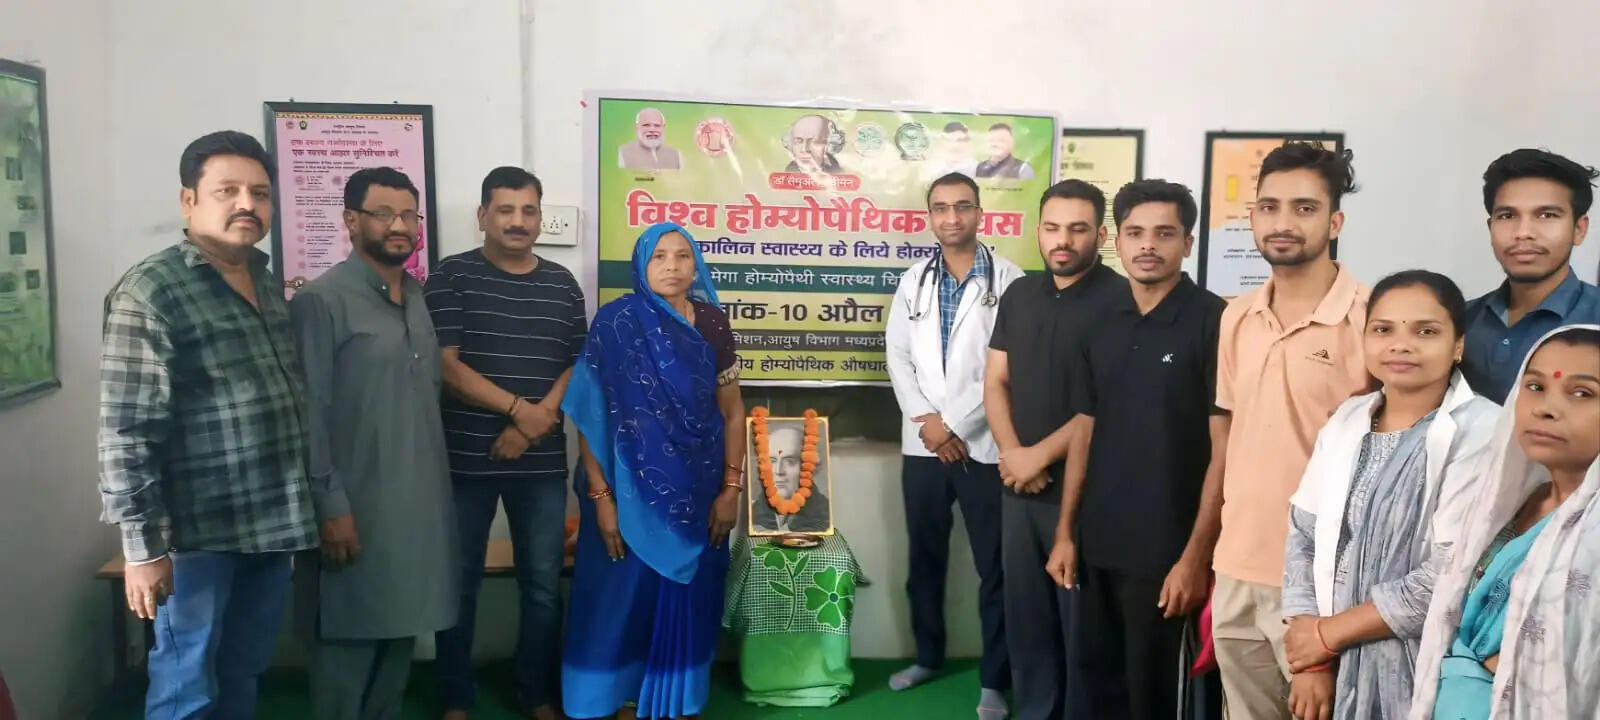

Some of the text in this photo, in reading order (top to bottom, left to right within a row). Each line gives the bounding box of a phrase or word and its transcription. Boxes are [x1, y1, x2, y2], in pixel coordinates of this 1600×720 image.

[626, 189, 1024, 237] विश्व होम्योपैथिक वस
[761, 242, 822, 257] स्वास्थ्य
[829, 240, 848, 258] के
[854, 240, 890, 259] लिये
[896, 241, 942, 259] होम्यो
[711, 267, 738, 283] मेगा
[745, 268, 815, 285] होम्योपैथी
[820, 274, 876, 287] स्वास्थ्य
[817, 297, 884, 324] अप्रैल
[806, 334, 839, 346] विभाग
[845, 333, 885, 348] मध्यप्रदे
[760, 355, 834, 373] होम्योपैथिक
